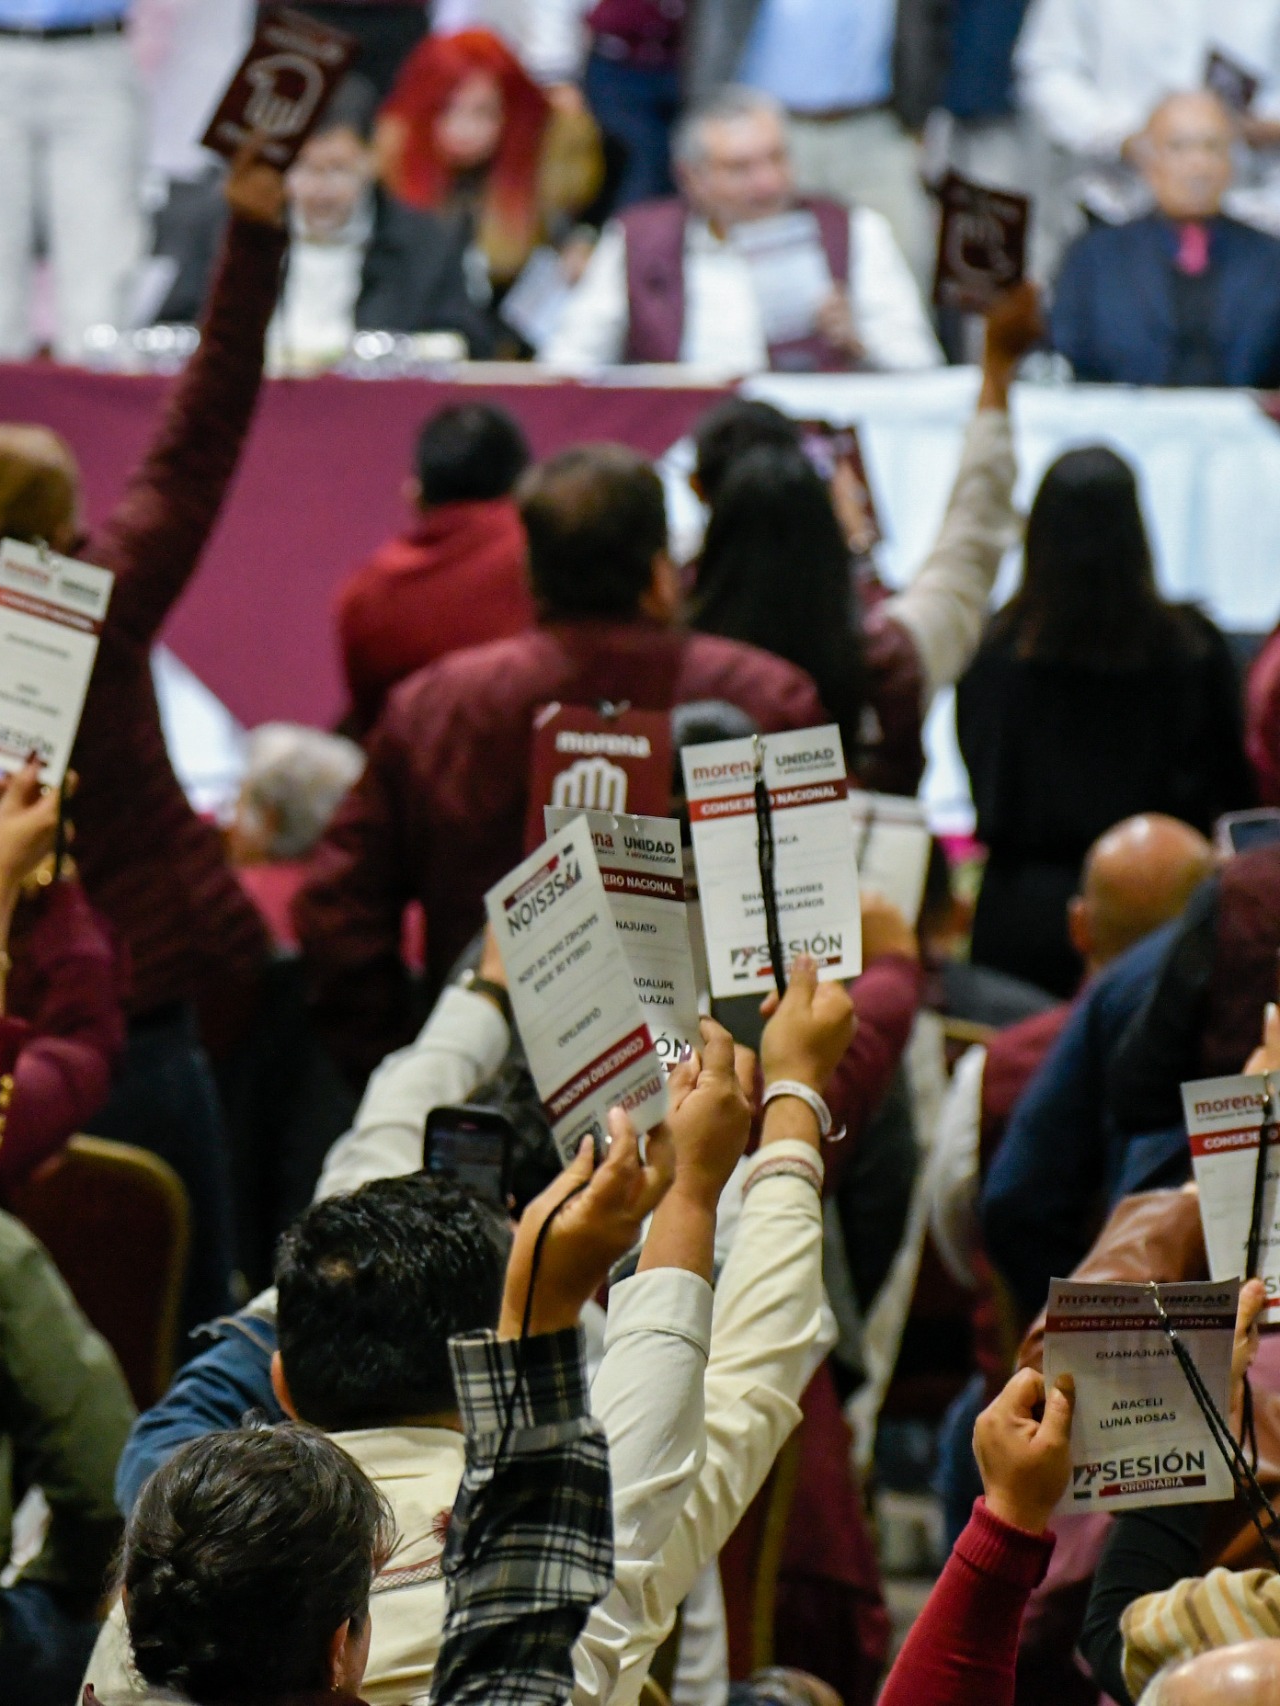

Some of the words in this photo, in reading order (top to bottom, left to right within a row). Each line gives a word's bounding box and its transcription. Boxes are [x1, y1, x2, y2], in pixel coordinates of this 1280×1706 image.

[556, 731, 651, 758] morena
[693, 760, 753, 780] moren
[775, 748, 835, 767] UNIDAD
[777, 786, 838, 805] NACIONAL
[624, 836, 675, 855] UNIDAD
[627, 877, 676, 895] NACIONAL
[506, 873, 565, 937] SESIÓN
[616, 919, 657, 933] NAJUATO
[758, 932, 842, 963] SSIÓN
[634, 977, 674, 990] DALUPE
[639, 994, 674, 1005] LAZAR
[590, 1036, 645, 1083] CONSEJERO
[621, 1076, 663, 1113] more
[1060, 1318, 1145, 1328] CONSEJERO
[1148, 1317, 1221, 1327] NCIONAL
[1111, 1398, 1163, 1411] ARACELI
[1099, 1417, 1131, 1429] LUNA
[1136, 1411, 1177, 1424] ROSAS
[1102, 1448, 1205, 1482] SESIÓN
[1120, 1476, 1184, 1492] ORDINARIA
